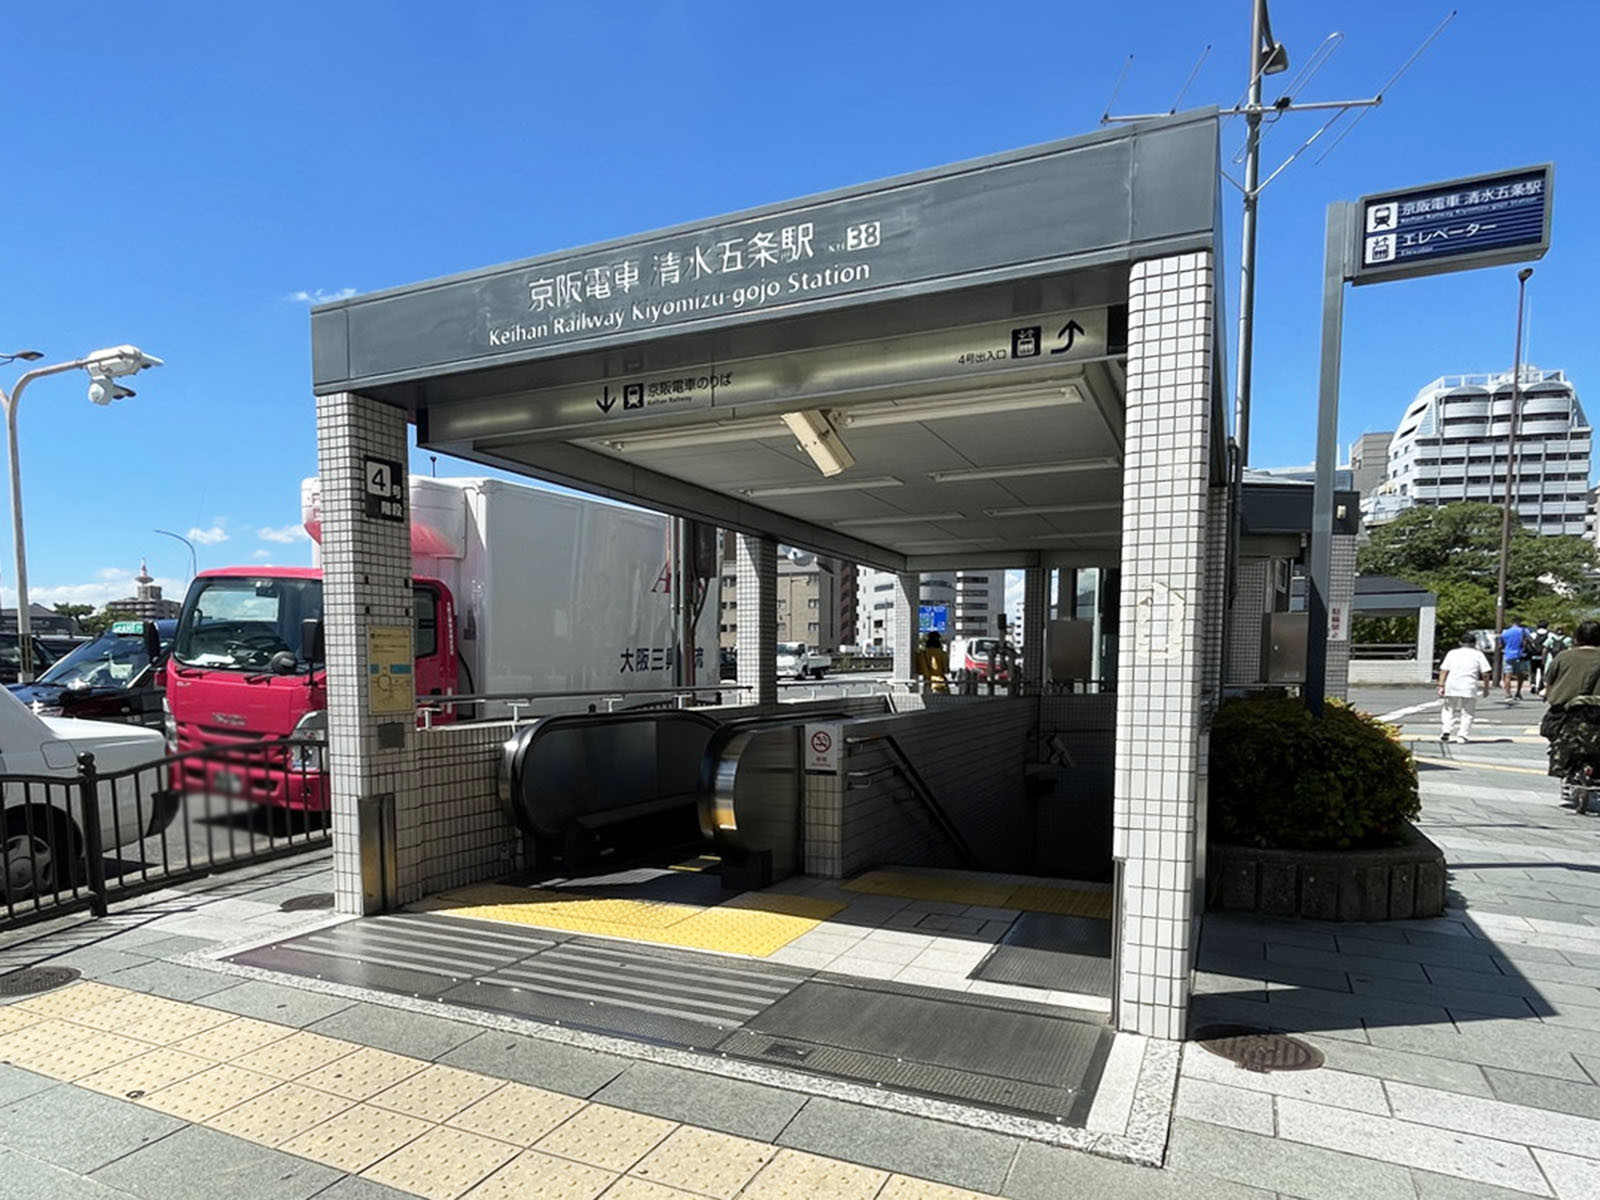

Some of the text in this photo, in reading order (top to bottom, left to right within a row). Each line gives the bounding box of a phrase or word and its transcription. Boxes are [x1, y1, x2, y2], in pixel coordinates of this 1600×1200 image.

[1464, 180, 1542, 206] 清水五条駅
[1402, 223, 1496, 246] エレベーター
[528, 260, 639, 312] 京阪電車
[651, 222, 814, 287] 清水五条駅
[850, 224, 877, 249] 38
[489, 322, 548, 346] Keihan
[553, 308, 625, 336] Railway
[788, 263, 870, 292] Station
[958, 349, 1006, 364] 4号出入口
[648, 372, 733, 397] 京阪電車のりば
